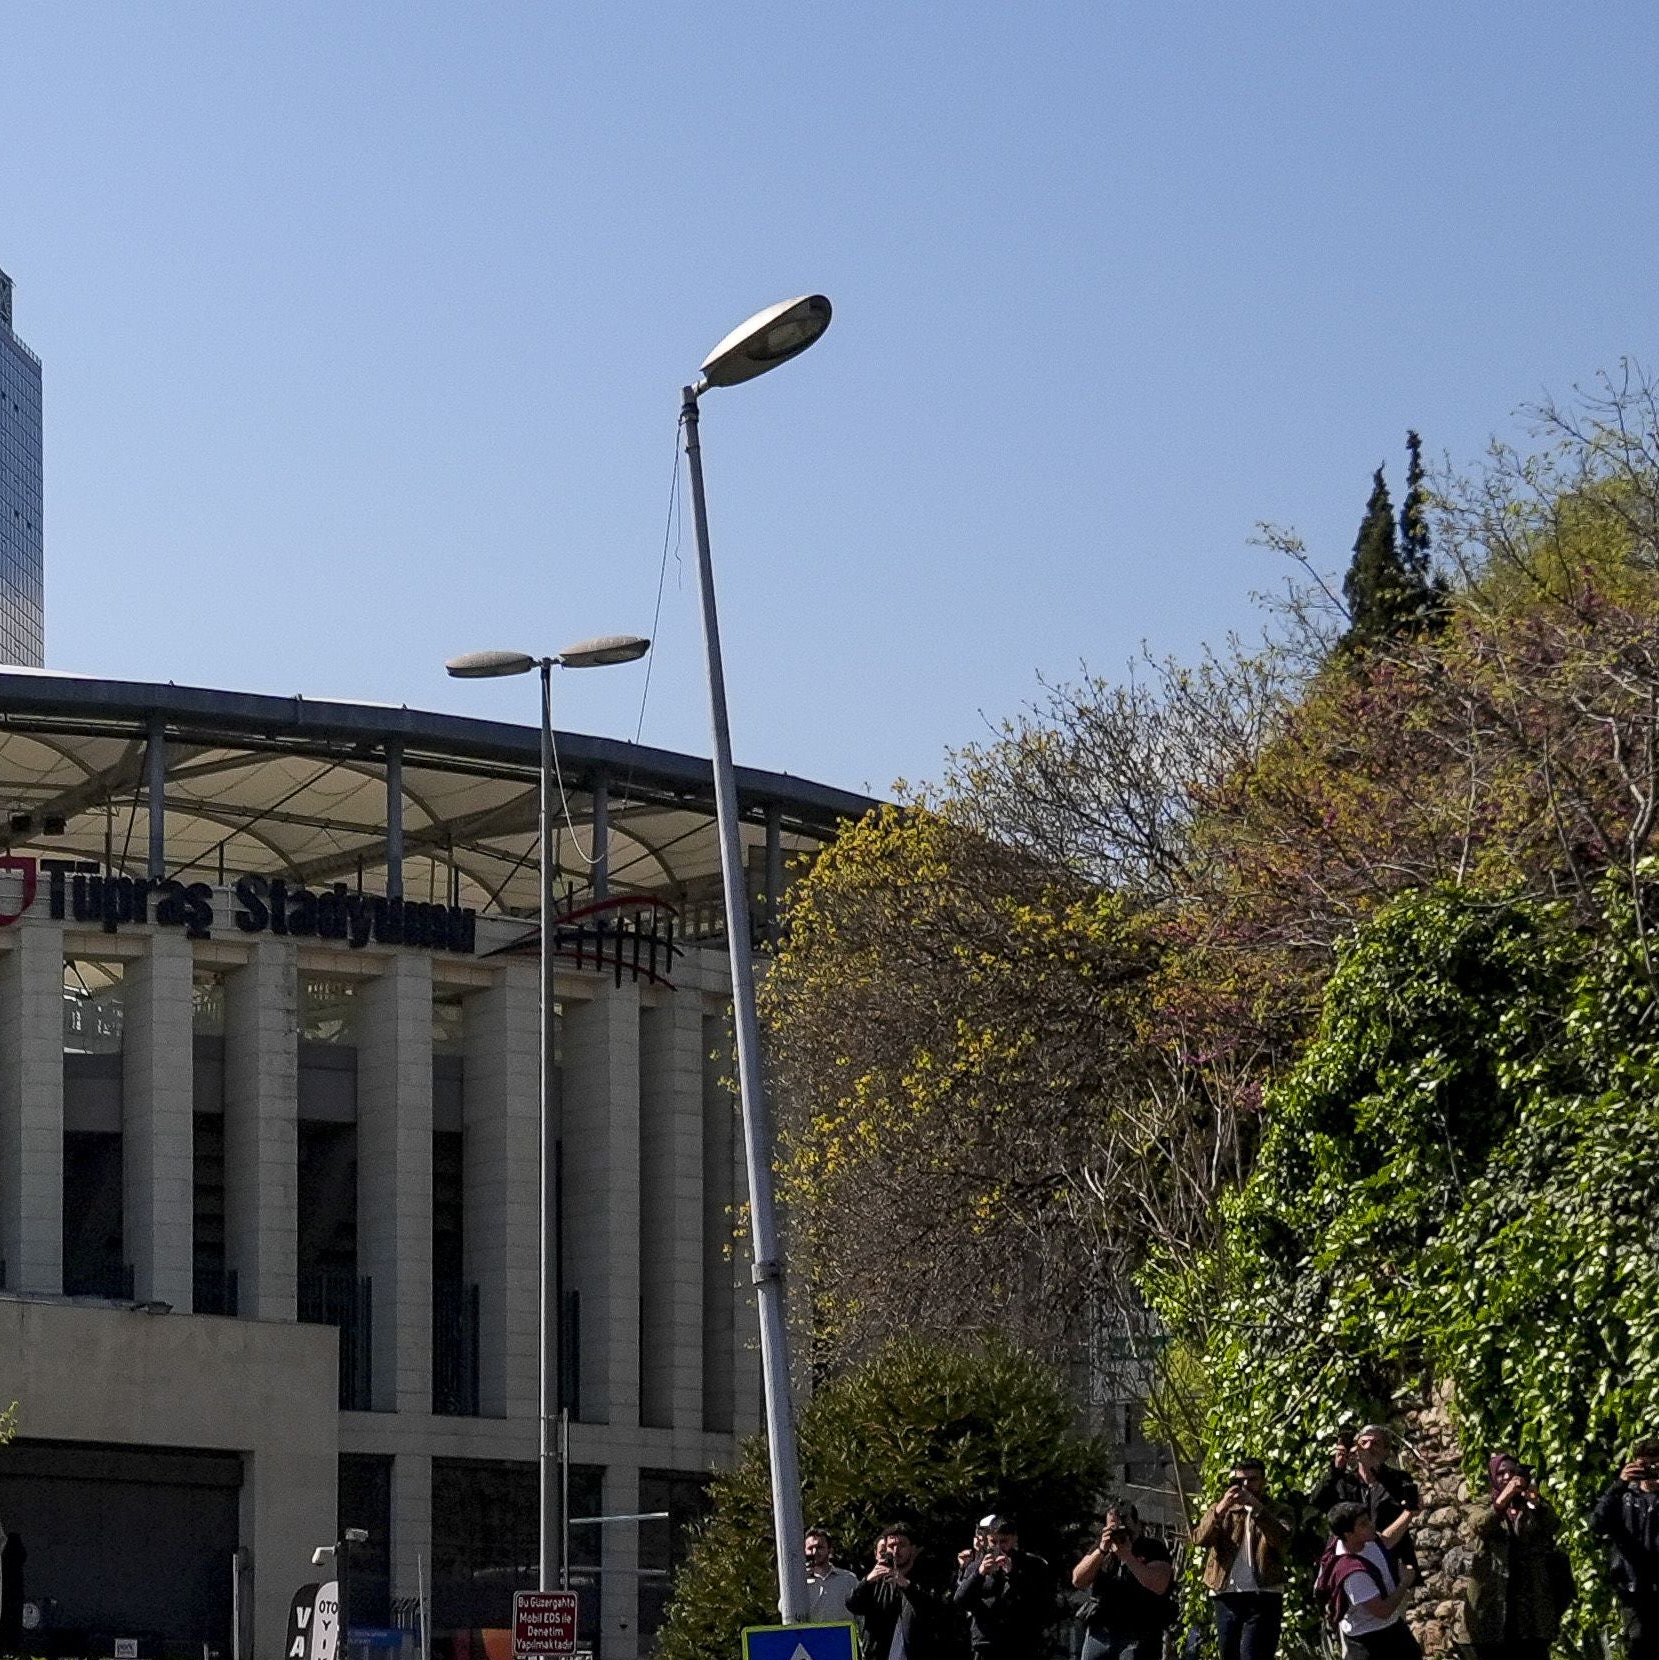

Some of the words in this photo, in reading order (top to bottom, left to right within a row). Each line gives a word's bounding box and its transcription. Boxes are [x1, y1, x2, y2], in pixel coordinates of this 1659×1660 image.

[318, 1600, 339, 1615] OTO
[519, 1612, 542, 1624] Mobil
[527, 1626, 564, 1637] Denetim
